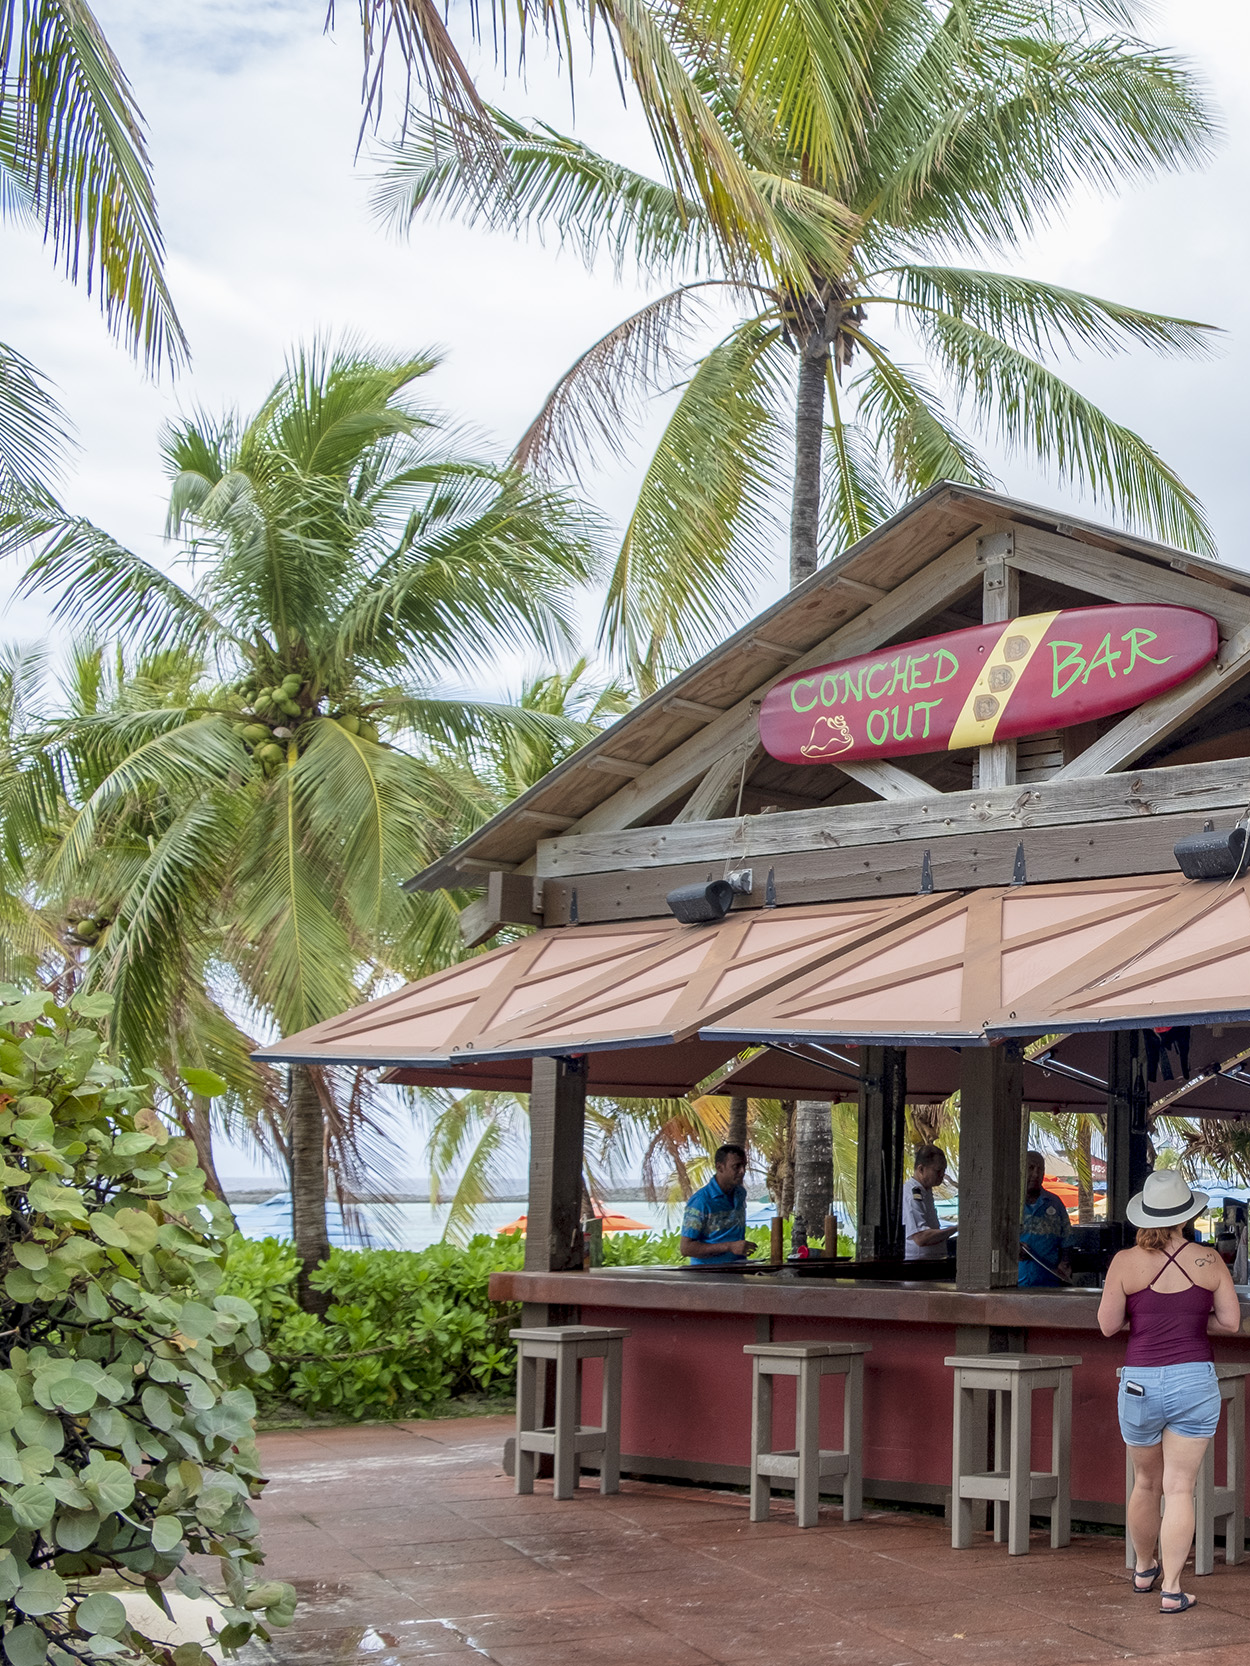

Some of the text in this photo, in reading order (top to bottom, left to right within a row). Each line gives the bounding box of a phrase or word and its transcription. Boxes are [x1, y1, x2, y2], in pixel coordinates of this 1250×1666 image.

[790, 648, 959, 713] CONCHED
[1047, 627, 1175, 699] BAR
[866, 697, 943, 746] OUT
